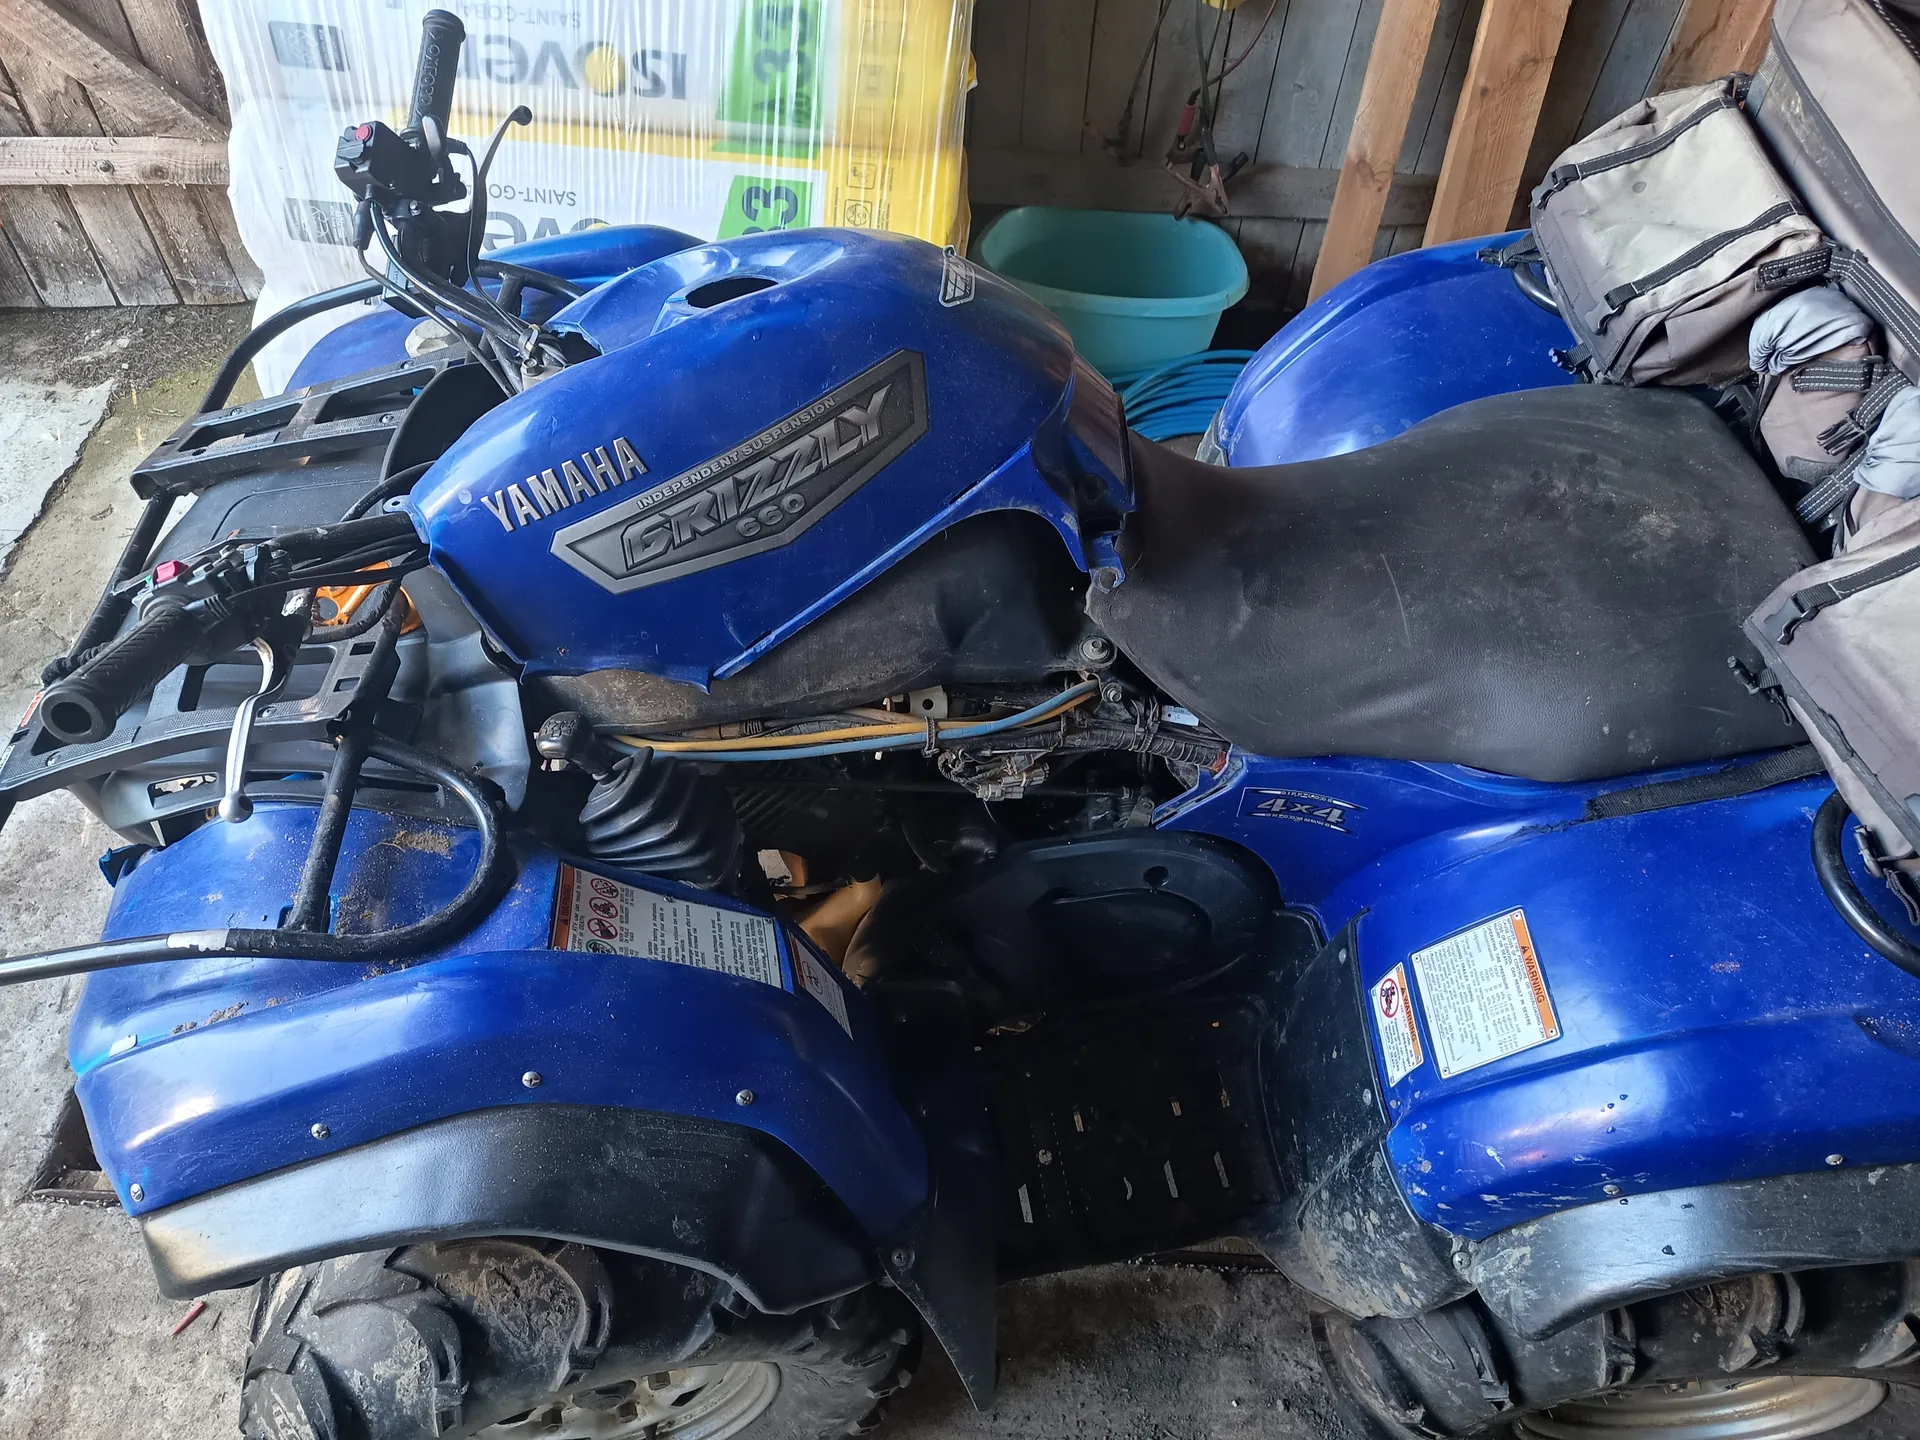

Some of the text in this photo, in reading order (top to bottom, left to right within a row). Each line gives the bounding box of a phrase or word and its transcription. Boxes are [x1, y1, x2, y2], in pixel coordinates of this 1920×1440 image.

[637, 396, 836, 509] INDEPENDENT SUSPENSION
[481, 437, 648, 533] YAMAHA
[621, 383, 893, 571] GRIZZLY
[735, 493, 806, 537] 660
[1256, 798, 1347, 824] 4x4
[560, 883, 571, 916] WARNING
[1524, 954, 1545, 1003] WARNING
[1402, 995, 1416, 1042] WARNING
